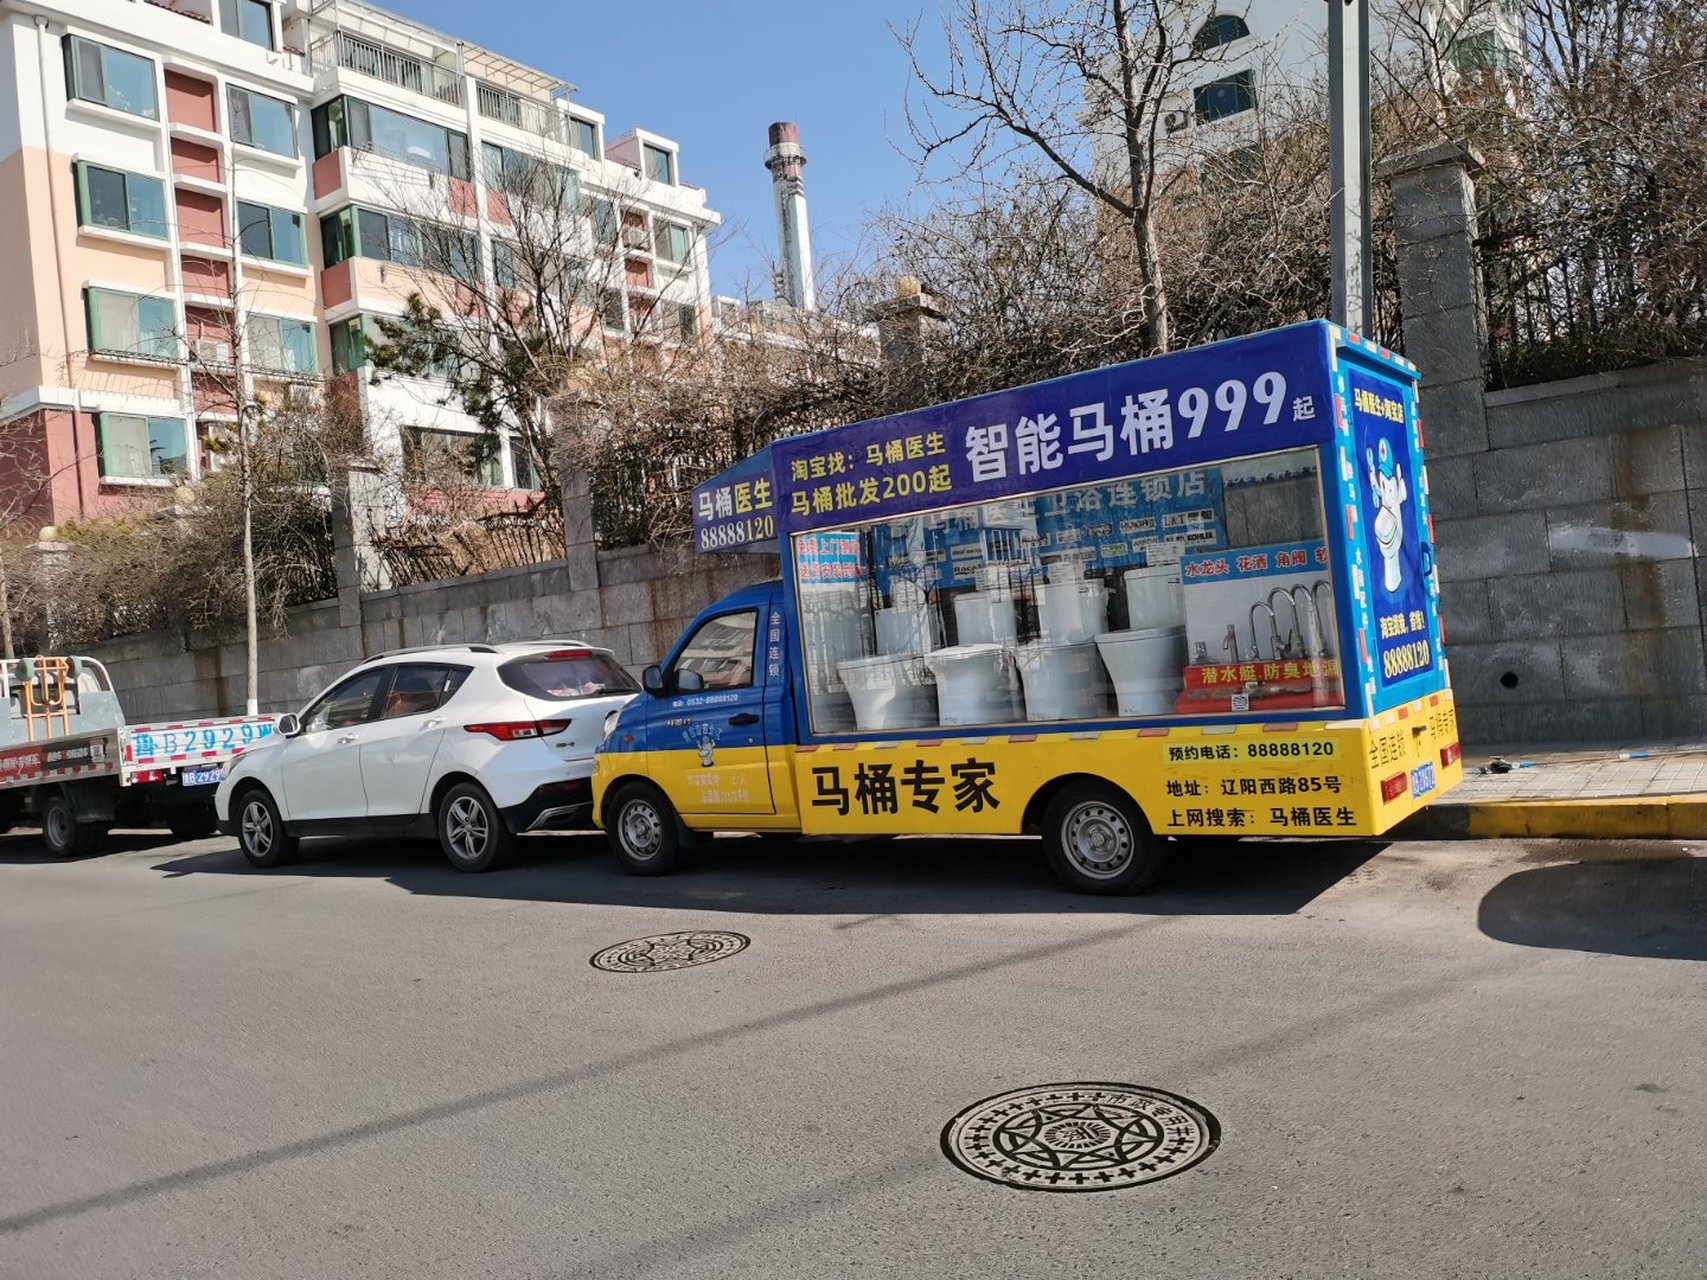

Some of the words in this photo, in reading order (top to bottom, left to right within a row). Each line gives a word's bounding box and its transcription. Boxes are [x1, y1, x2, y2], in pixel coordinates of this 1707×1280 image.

[966, 371, 1316, 482] 智能马桶999起
[791, 432, 946, 482] 淘宝找：马桶医生
[698, 477, 773, 521] 马桶医生
[791, 464, 952, 517] 马桶批发200起
[700, 516, 775, 550] 88888120
[1186, 559, 1230, 577] 水龙头
[1238, 553, 1268, 572] 花洒
[1276, 549, 1307, 568] 角阀
[1383, 639, 1430, 679] 88888120
[1168, 741, 1334, 761] 预约电话：88888120
[812, 757, 1001, 816] 马桶专家
[1166, 776, 1342, 798] 地址：辽阳西路85号
[1167, 806, 1357, 828] 上网搜索：马桶医生
